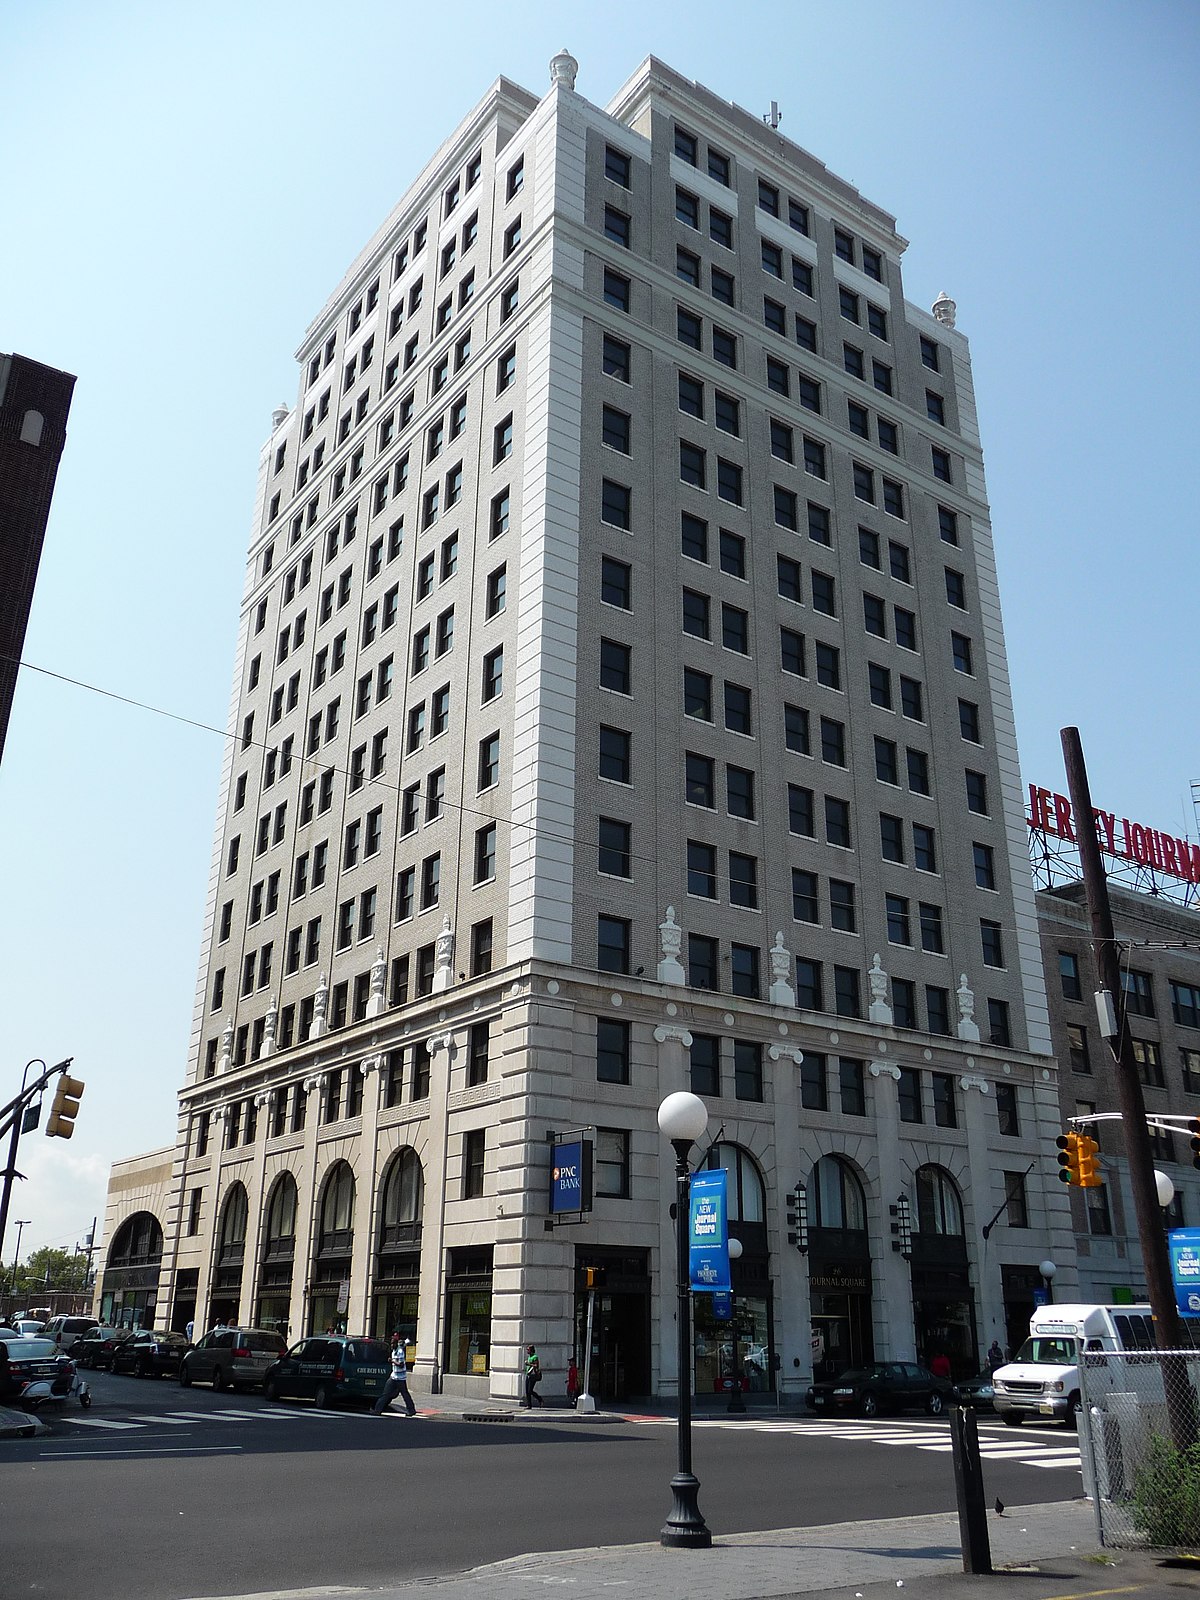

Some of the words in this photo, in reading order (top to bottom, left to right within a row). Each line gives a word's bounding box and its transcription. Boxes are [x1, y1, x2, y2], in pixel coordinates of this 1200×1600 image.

[1027, 783, 1115, 855] JERY
[560, 1166, 577, 1178] PNC
[560, 1178, 580, 1190] BANK
[699, 1205, 712, 1213] NEW
[695, 1212, 717, 1224] Journal
[695, 1224, 715, 1236] Square
[841, 1278, 867, 1288] SQUARE
